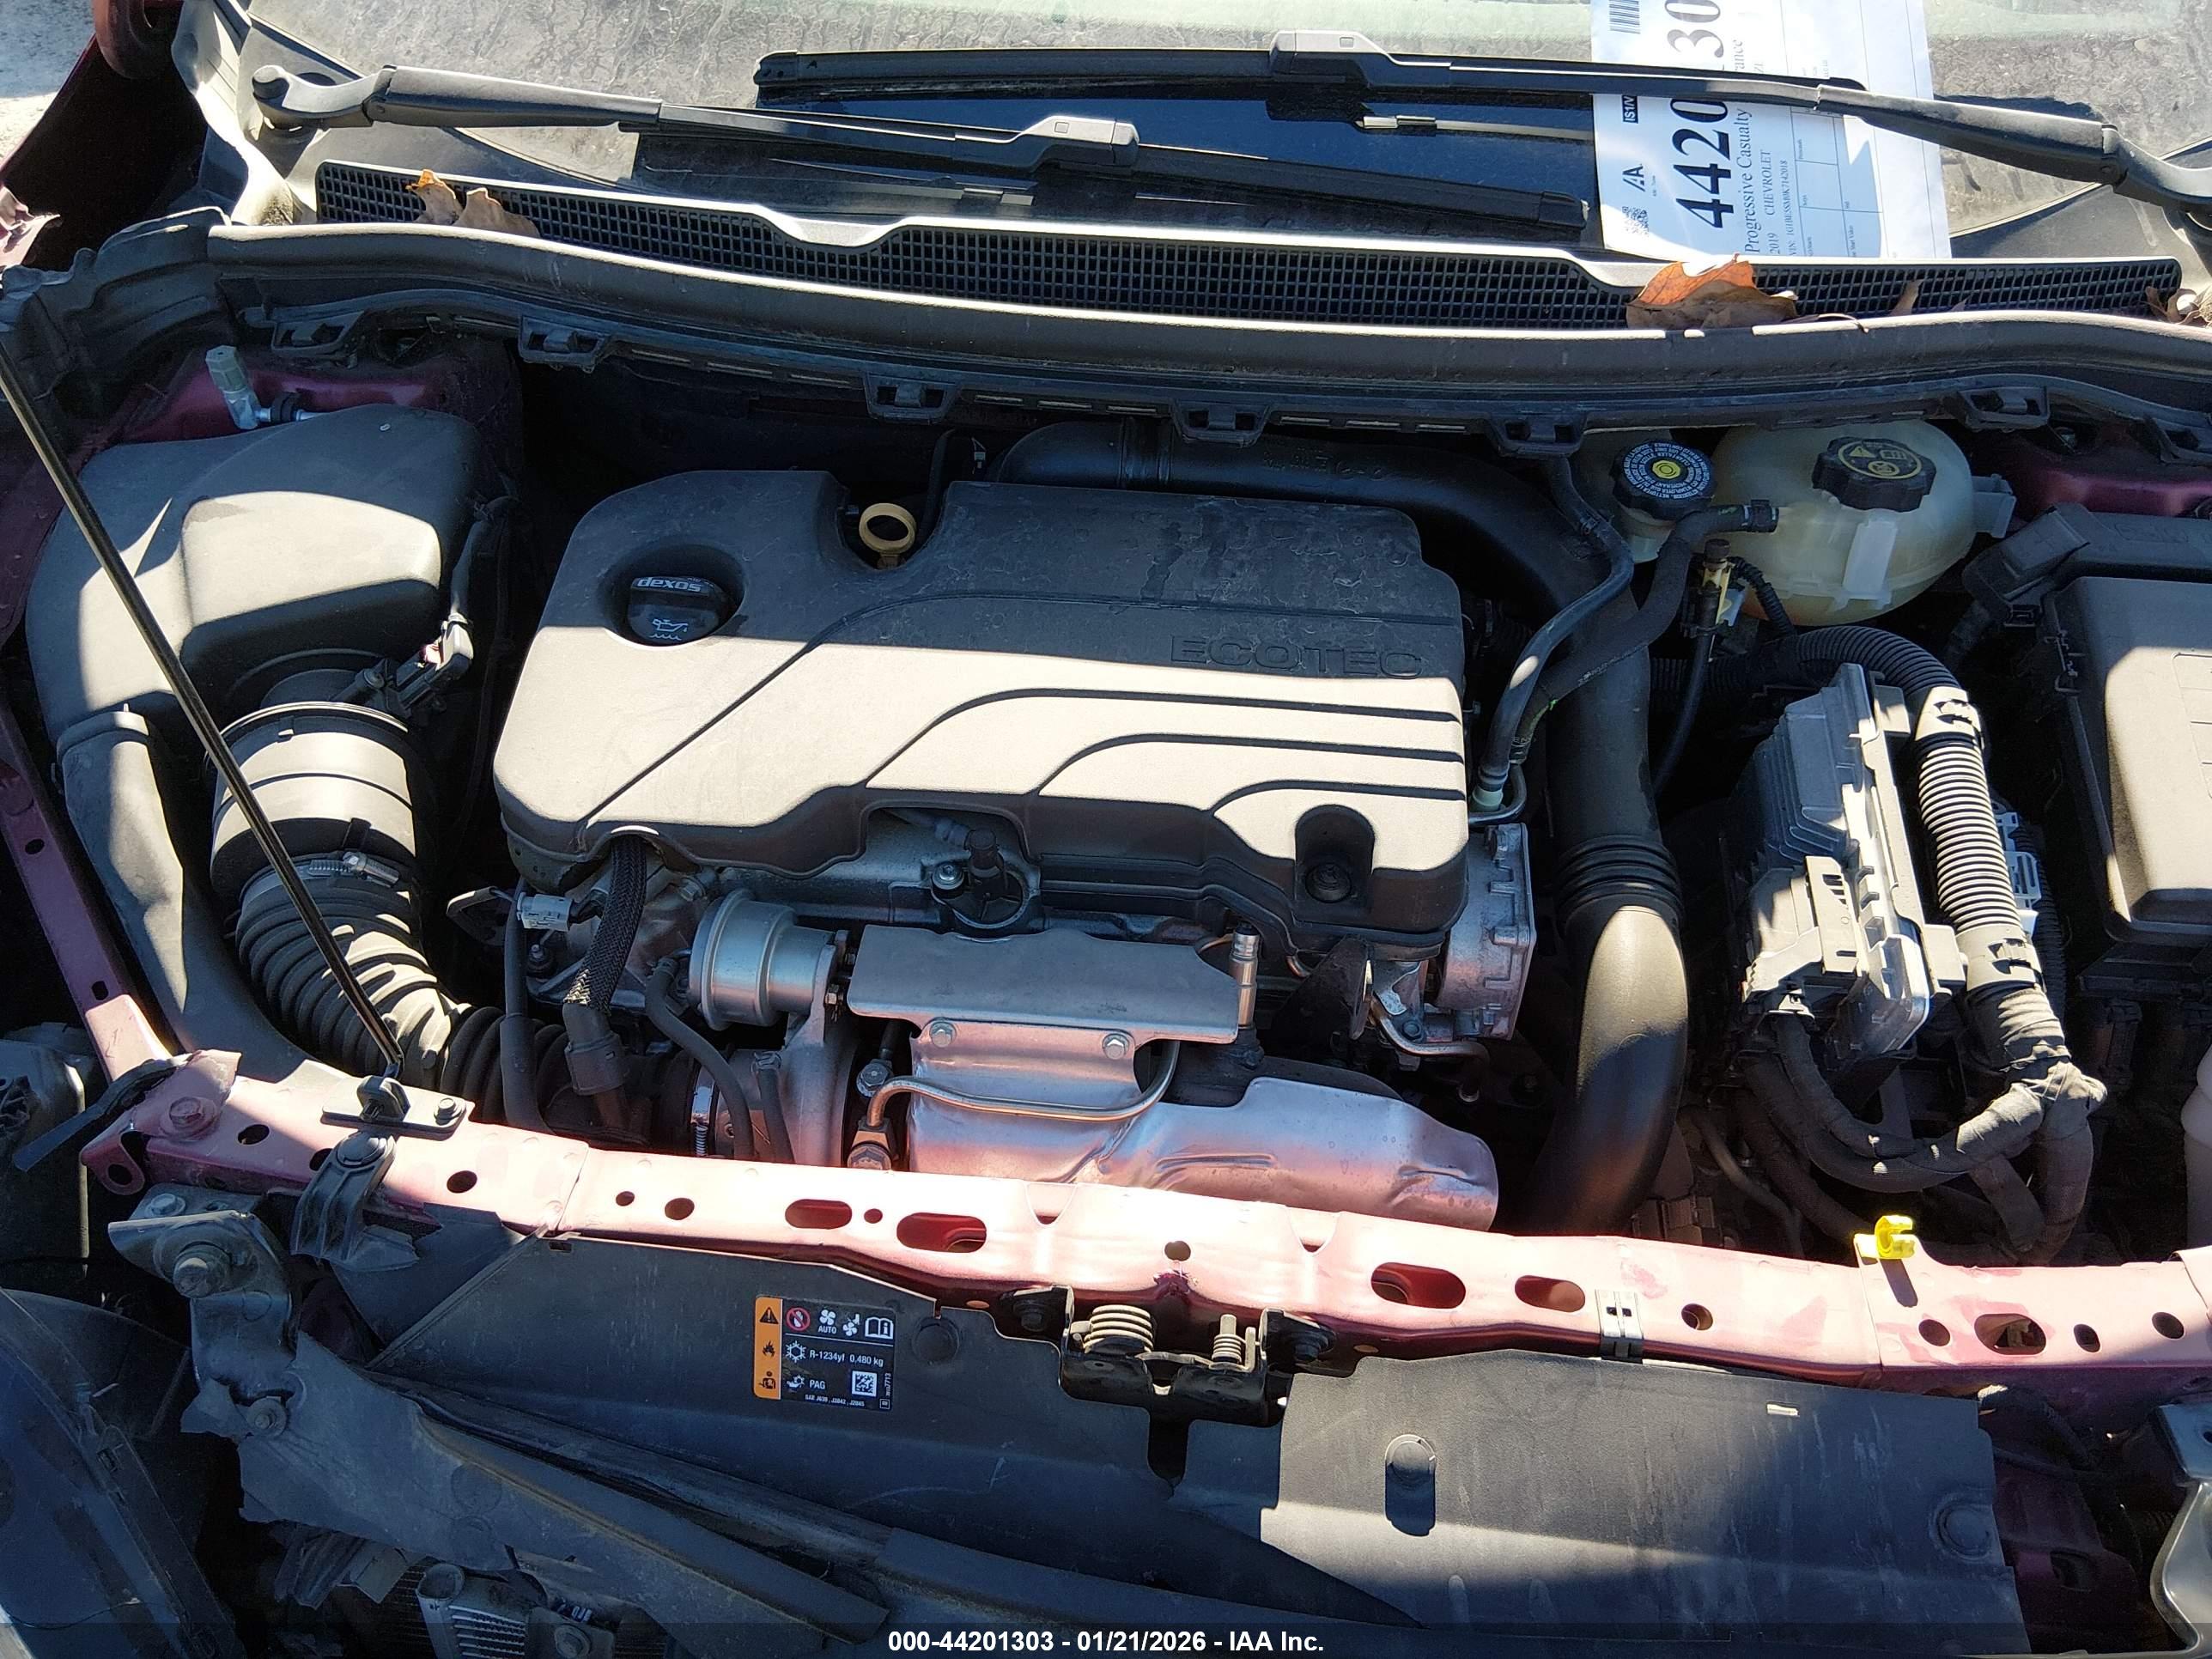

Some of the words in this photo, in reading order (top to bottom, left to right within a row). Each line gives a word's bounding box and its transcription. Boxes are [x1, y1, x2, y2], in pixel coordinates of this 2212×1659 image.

[1733, 107, 1753, 169] Casualty
[1759, 149, 1776, 216] CHEVROLET
[1738, 173, 1762, 253] Progressive
[1767, 232, 1780, 255] 2019
[637, 577, 702, 592] dexos
[1170, 635, 1424, 680] ECOTEC
[817, 1325, 837, 1334] AUTO
[809, 1349, 845, 1363] R-1234yf
[872, 1355, 884, 1367] kg
[809, 1379, 826, 1389] PAG
